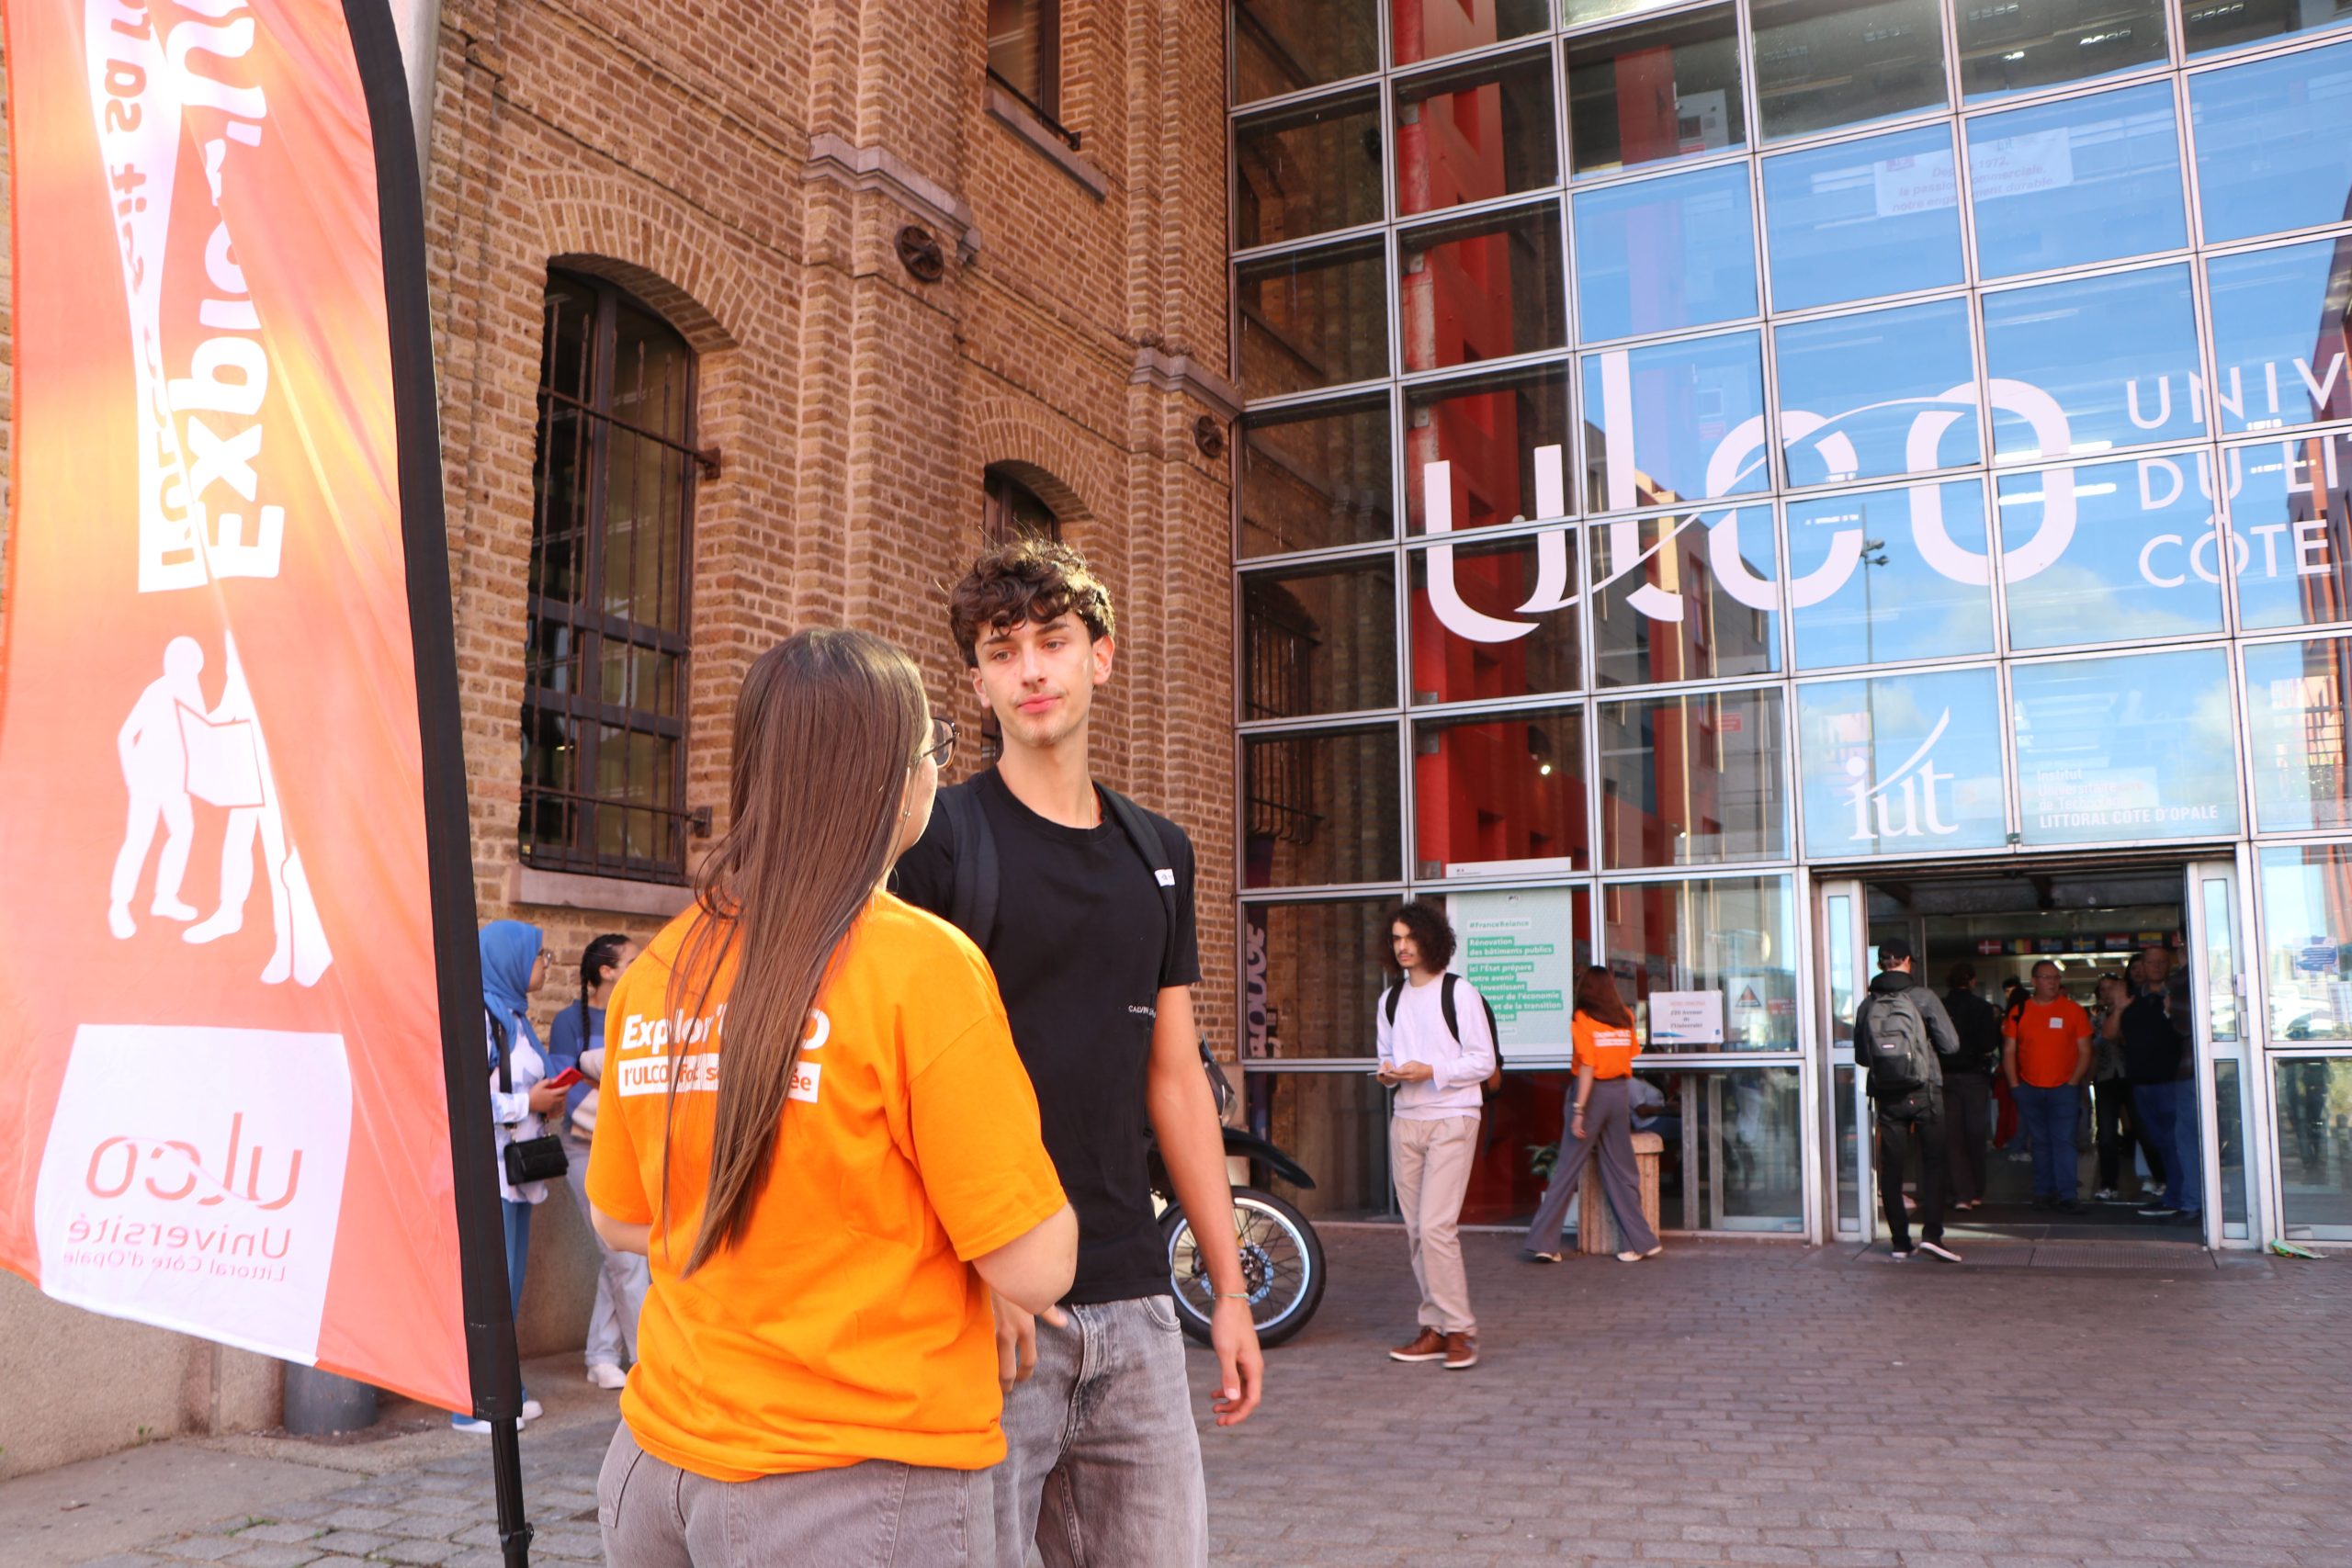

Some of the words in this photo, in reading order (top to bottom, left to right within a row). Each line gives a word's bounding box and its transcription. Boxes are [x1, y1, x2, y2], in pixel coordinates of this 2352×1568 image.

[1913, 177, 1959, 197] passio
[2138, 447, 2243, 511] DU
[1424, 350, 2078, 643] ulco
[1843, 705, 1960, 840] iut
[2037, 768, 2083, 782] Institut
[2039, 797, 2053, 811] de
[2040, 812, 2109, 829] LITTORAL
[2155, 805, 2219, 822] D'OPALE
[1469, 919, 1530, 929] #FranceRelance
[1470, 938, 1513, 946] Rénovation
[1469, 948, 1483, 956] des
[1484, 946, 1523, 955] bâtiments
[1524, 945, 1553, 956] publics
[1506, 992, 1516, 1000] de
[1503, 1002, 1514, 1010] de
[1515, 1001, 1523, 1010] la
[1524, 1000, 1562, 1010] transition
[624, 1063, 670, 1087] l'ULCO
